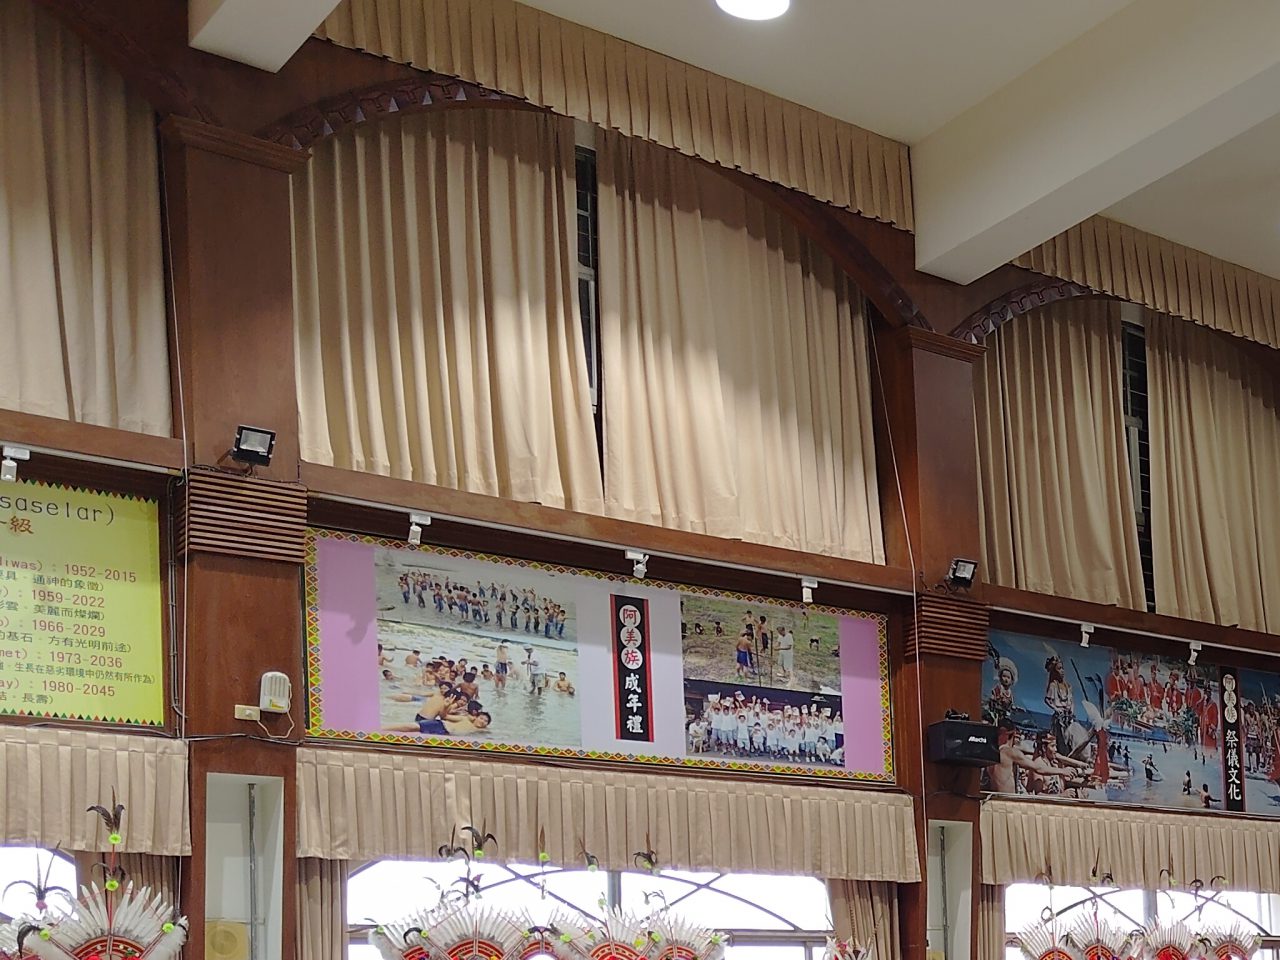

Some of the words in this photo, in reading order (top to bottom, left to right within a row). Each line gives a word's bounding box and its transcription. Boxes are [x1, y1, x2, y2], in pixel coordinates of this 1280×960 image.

[64, 563, 136, 583] 1952-2015
[31, 589, 105, 608] 1959-2022
[32, 619, 106, 638] 1966-2029
[49, 651, 123, 669] 1973-2036
[42, 679, 116, 697] 1980-2045
